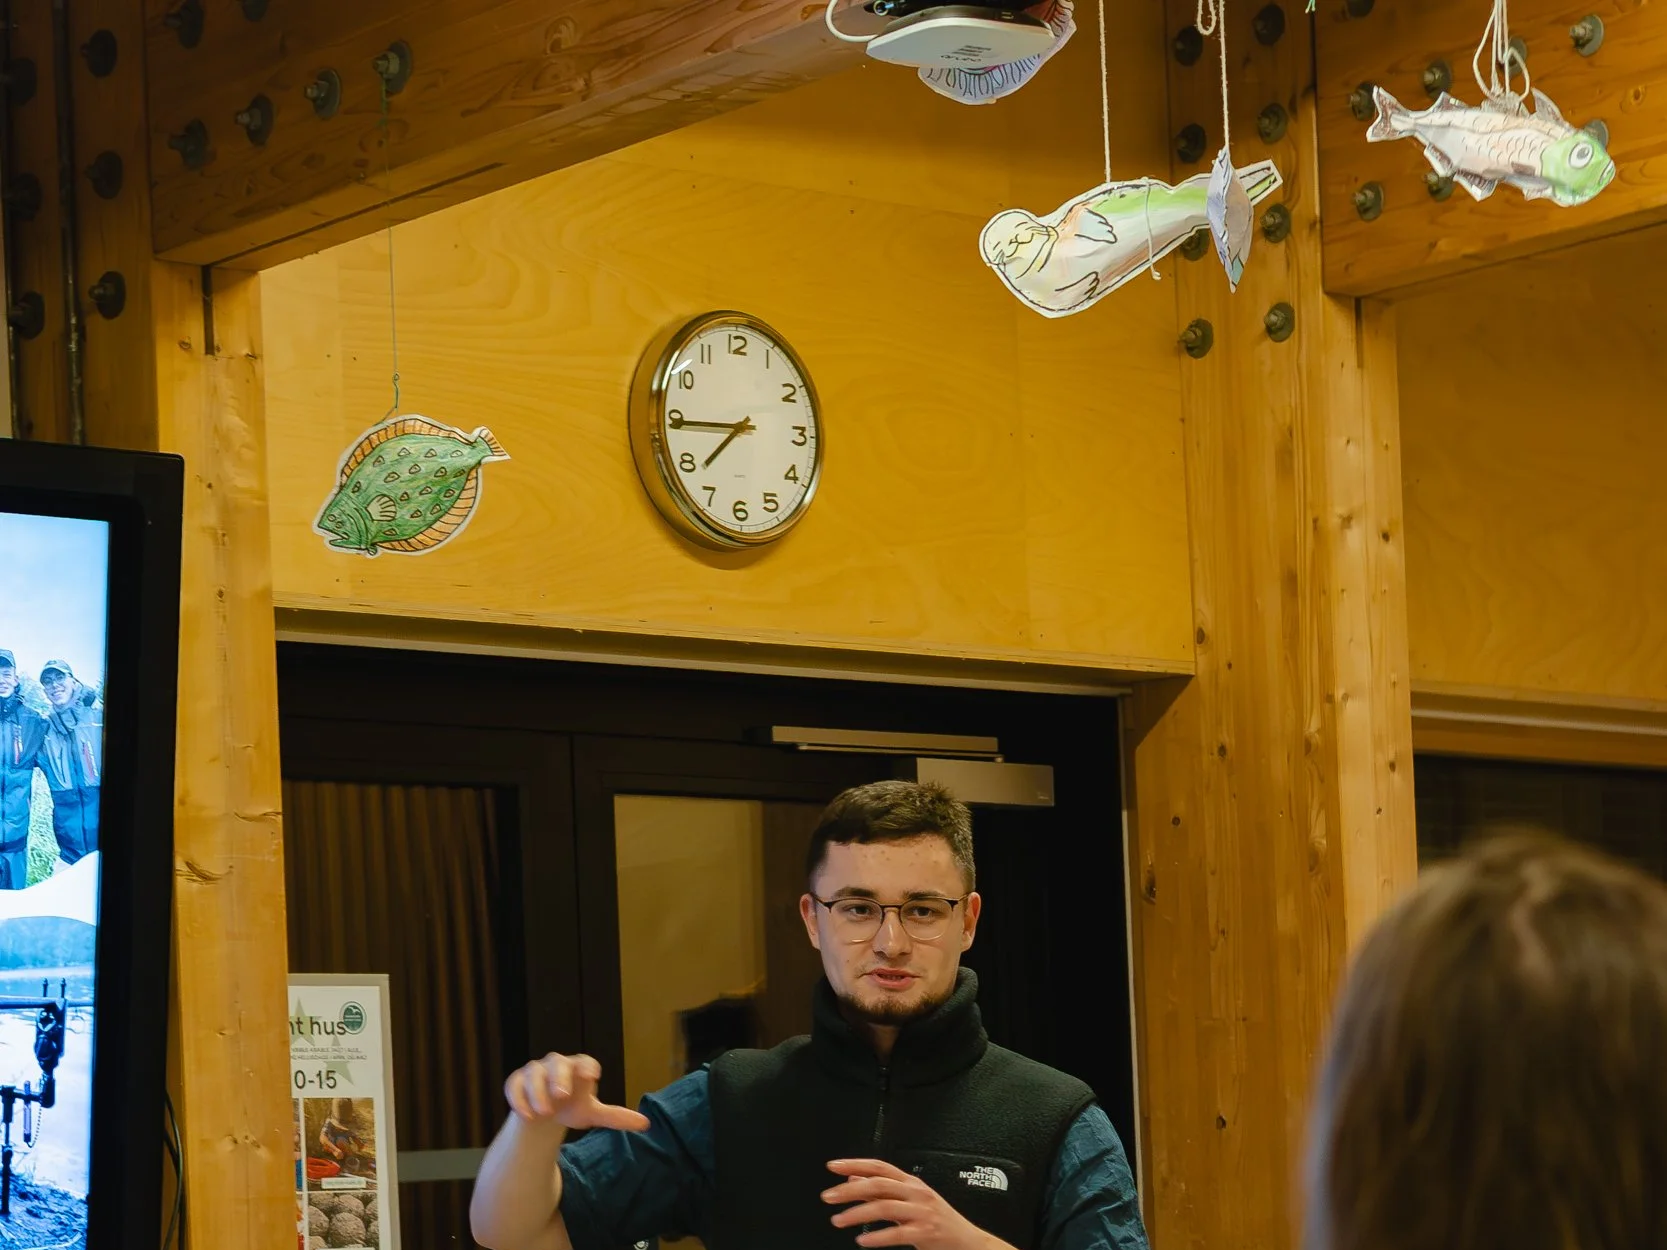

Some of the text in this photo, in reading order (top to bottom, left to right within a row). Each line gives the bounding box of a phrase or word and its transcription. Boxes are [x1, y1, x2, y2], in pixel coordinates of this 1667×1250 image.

[700, 343, 712, 365] 11
[727, 333, 748, 356] 12
[765, 349, 770, 369] 1
[678, 369, 695, 390] 10
[781, 383, 797, 404] 2
[668, 409, 684, 430] 9
[791, 425, 808, 447] 3
[679, 452, 696, 473] 8
[784, 464, 799, 484] 4
[701, 485, 716, 508] 7
[762, 492, 779, 513] 5
[732, 500, 749, 521] 6
[310, 1016, 347, 1036] hus
[959, 1171, 993, 1181] NORTH
[974, 1165, 994, 1175] THE
[967, 1179, 992, 1188] FACE
